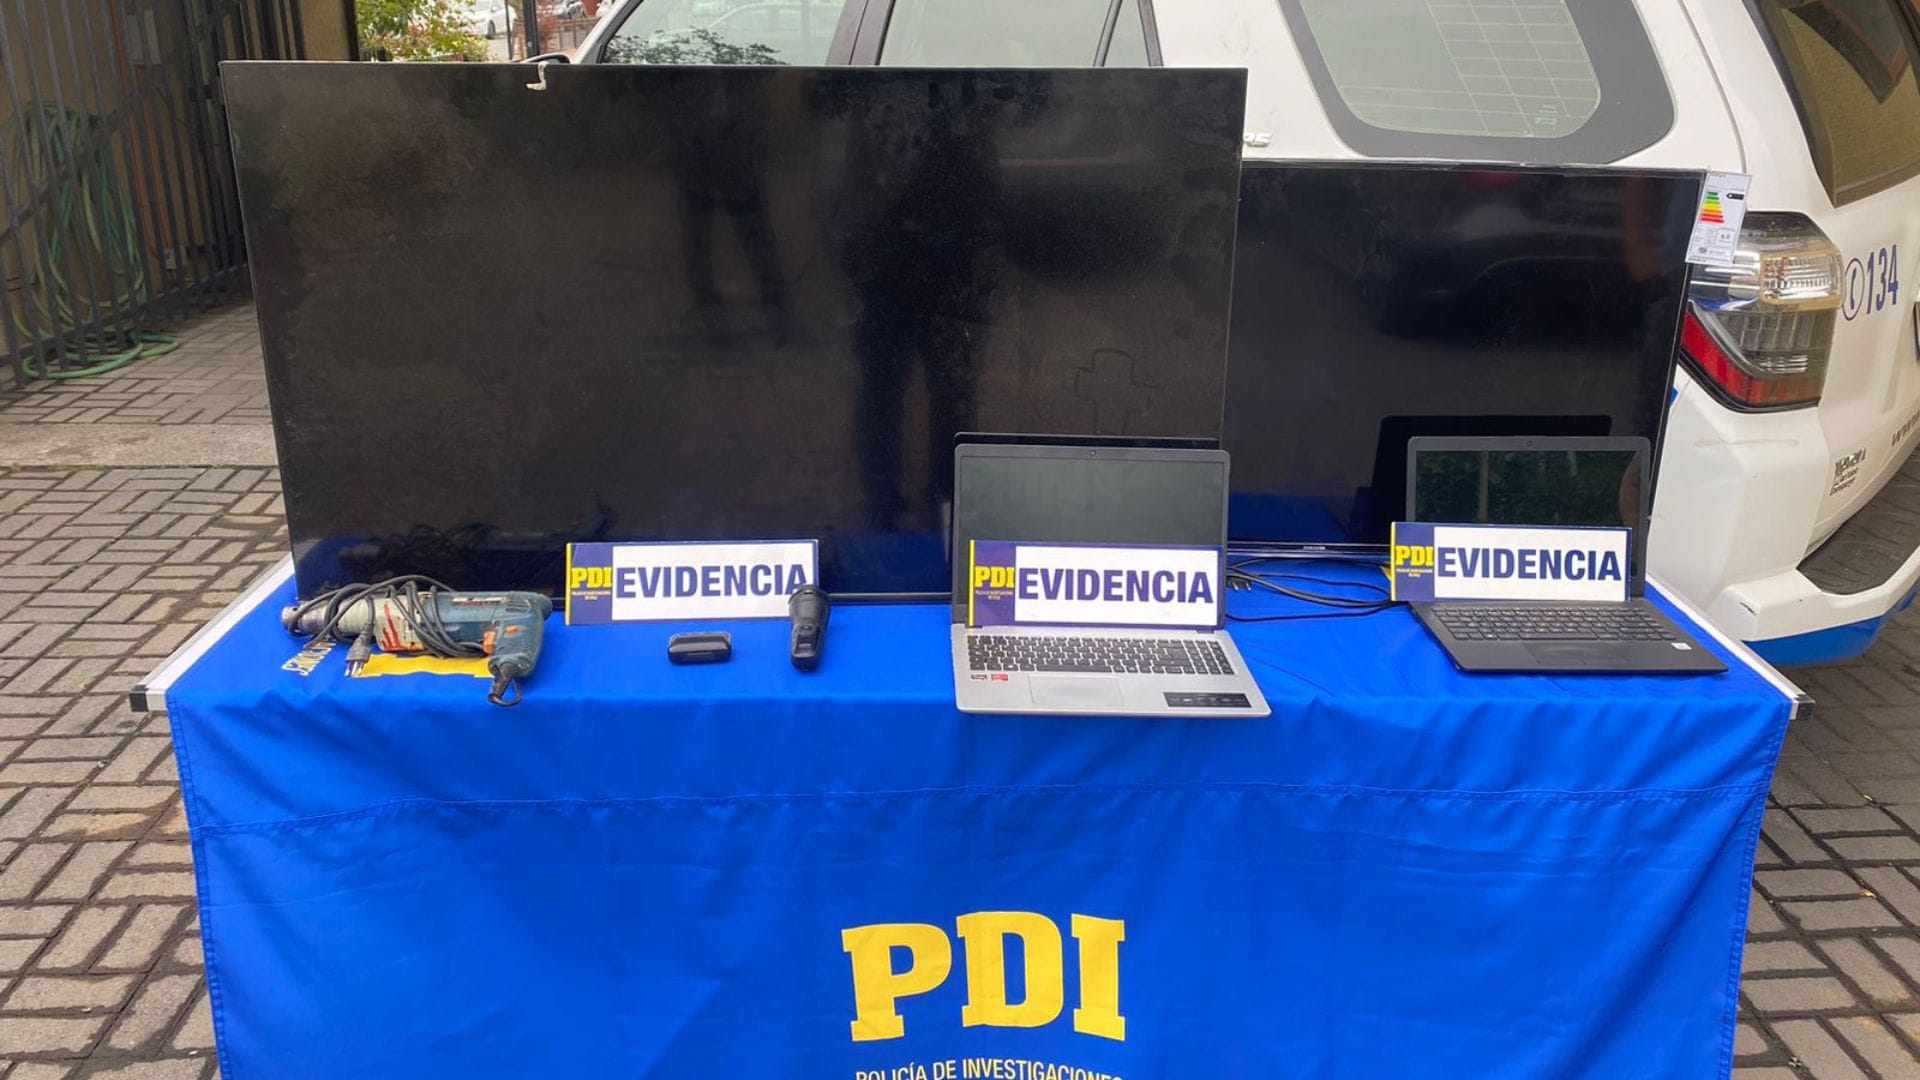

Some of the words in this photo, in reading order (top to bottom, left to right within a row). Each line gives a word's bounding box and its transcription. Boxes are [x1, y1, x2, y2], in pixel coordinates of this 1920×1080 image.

[1866, 244, 1899, 314] 134
[1395, 545, 1434, 566] PDI
[1438, 547, 1621, 581] EVIDENCIA
[571, 566, 612, 589] PDI
[616, 564, 806, 599] EVIDENCIA
[974, 566, 1014, 589] PDI
[1018, 567, 1214, 604] EVIDENCIA
[841, 910, 1125, 1042] PDI
[933, 1060, 957, 1080] DE
